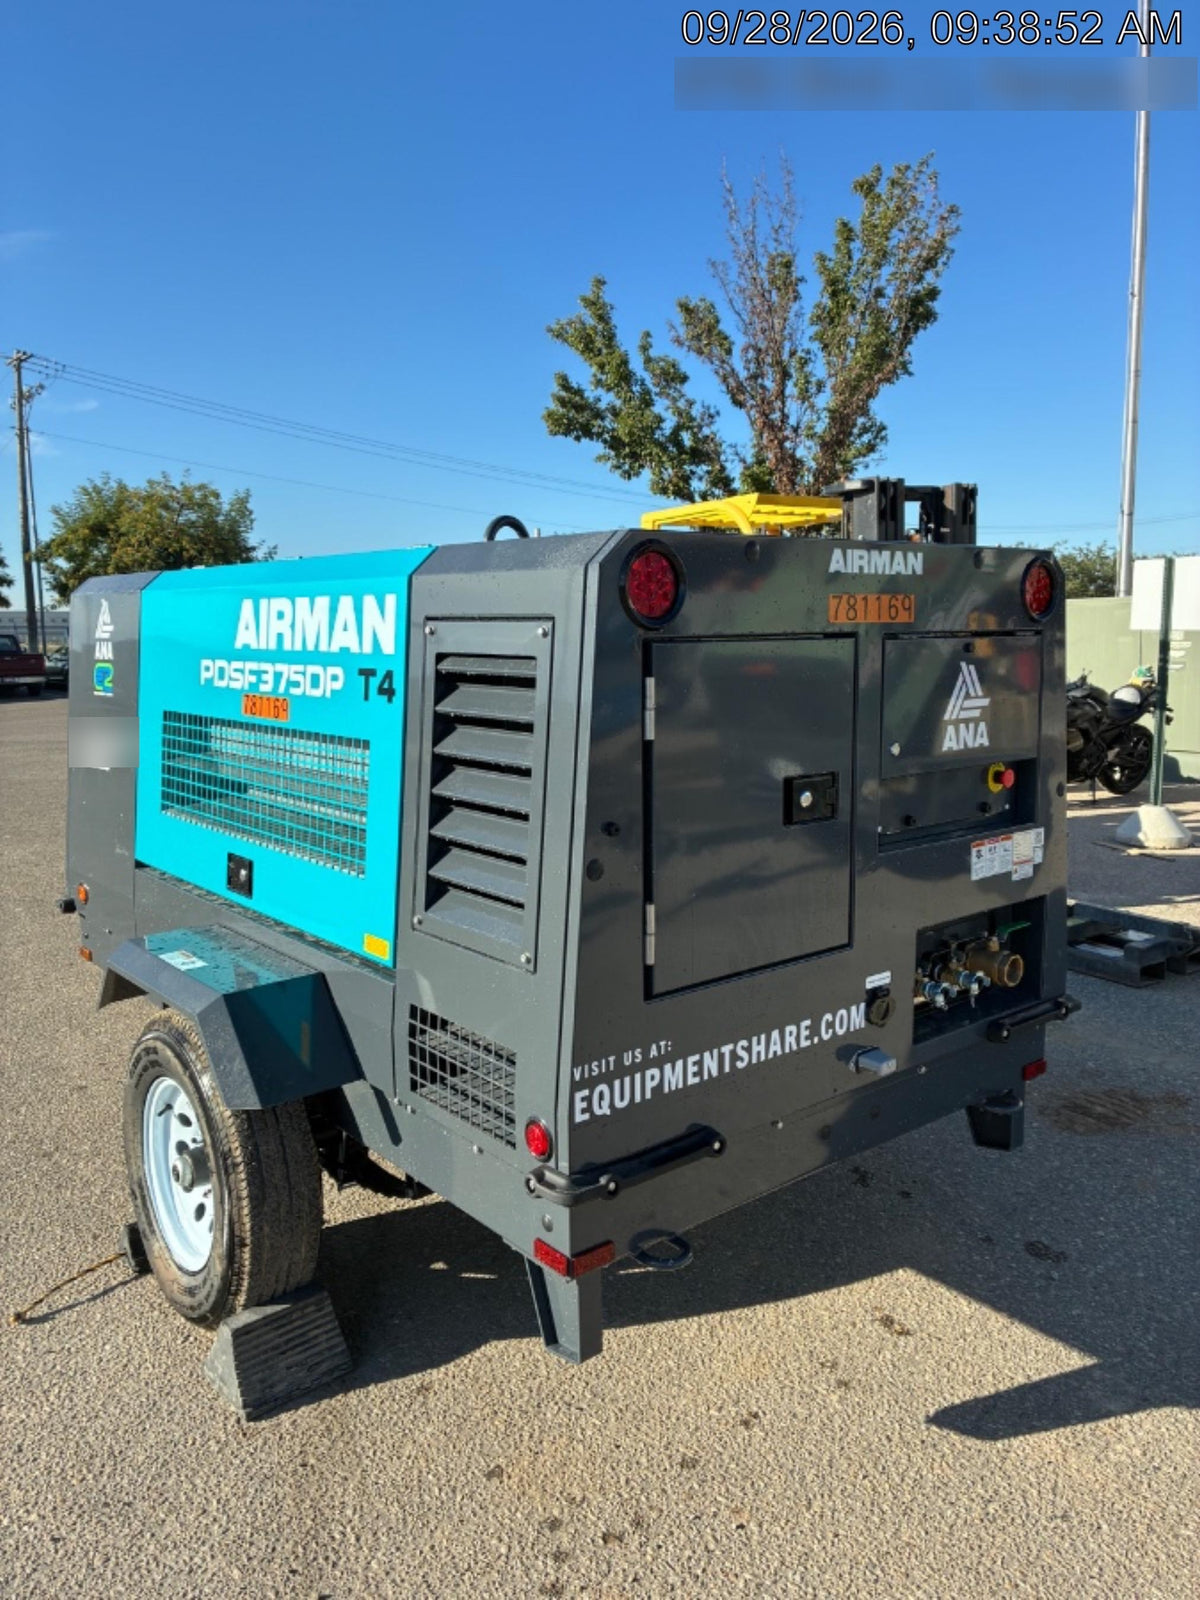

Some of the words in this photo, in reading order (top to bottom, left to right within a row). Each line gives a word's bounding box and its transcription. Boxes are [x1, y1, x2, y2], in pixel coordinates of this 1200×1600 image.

[828, 548, 923, 576] AIRMAN
[234, 593, 397, 655] AIRMAN
[831, 594, 912, 622] 781169
[95, 642, 114, 660] ANA
[200, 659, 345, 698] PDSF375DP
[358, 668, 396, 704] T4
[942, 721, 990, 752] ANA
[573, 1056, 616, 1081] VISIT
[623, 1049, 643, 1066] US
[649, 1040, 672, 1059] AT:
[573, 1002, 867, 1124] EQUIPMENTSHARE.COM
